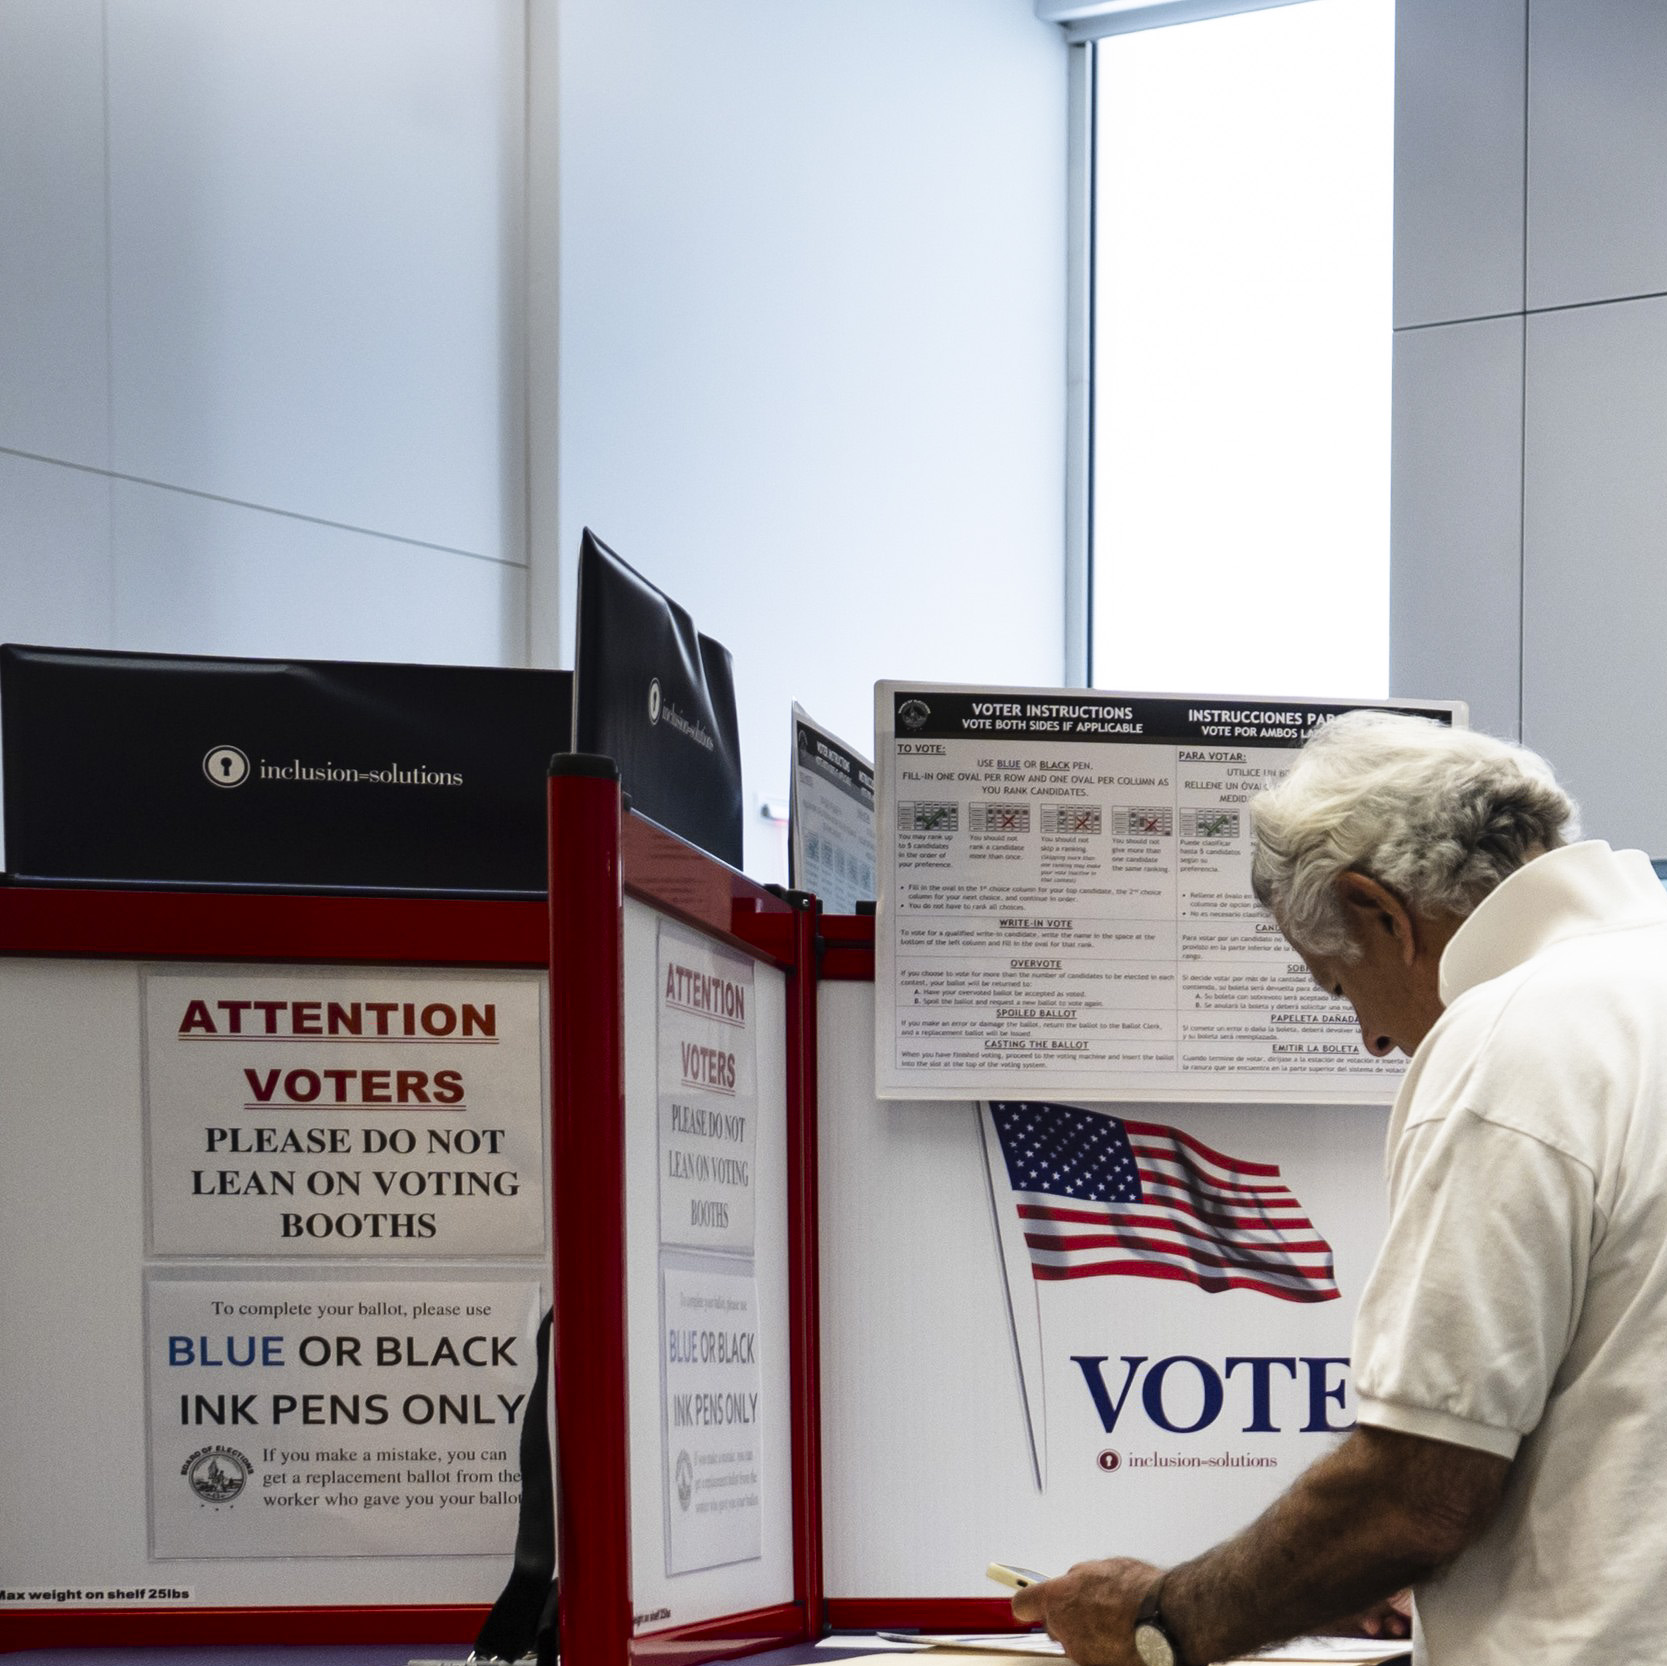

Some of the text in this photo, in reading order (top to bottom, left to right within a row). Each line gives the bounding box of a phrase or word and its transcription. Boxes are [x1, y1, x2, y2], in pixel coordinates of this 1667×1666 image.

[971, 702, 1134, 721] VOTER INSTRUCTIONS
[1188, 708, 1303, 726] INSTRUCCIONES
[961, 718, 1144, 735] VOTE BOTH SIDES IF APPLICABLE
[1201, 725, 1298, 740] VOTE POR AMBOS
[666, 962, 745, 1020] ATTENTION
[177, 999, 496, 1037] ATTENTION
[681, 1041, 736, 1088] VOTERS
[243, 1068, 465, 1103] VOTERS
[672, 1104, 746, 1143] PLEASE DO NOT
[204, 1127, 506, 1155] PLEASE DO NOT
[190, 1169, 520, 1197] LEAN ON VOTING
[669, 1150, 749, 1187] LEAN ON VOTING
[279, 1212, 437, 1239] BOOTHS
[690, 1199, 729, 1229] BOOTHS
[210, 1300, 492, 1320] To complete your ballot, please use
[168, 1335, 518, 1368] BLUE OR BLACK
[669, 1329, 755, 1364] BLUE OR BLACK
[1069, 1354, 1360, 1435] VOTE
[180, 1393, 527, 1427] INK PENS ONLY
[673, 1392, 758, 1427] INK PENS ONLY
[262, 1447, 508, 1466] If you make a mistake, you can
[262, 1469, 522, 1488] get a replacement ballot from the
[262, 1491, 320, 1507] worker
[324, 1491, 359, 1507] who
[363, 1495, 401, 1510] gave
[405, 1495, 434, 1509] you
[439, 1494, 476, 1509] your
[27, 1589, 83, 1603] weight
[84, 1591, 105, 1600] on
[107, 1588, 146, 1600] shelf
[147, 1588, 190, 1600] 25lbs
